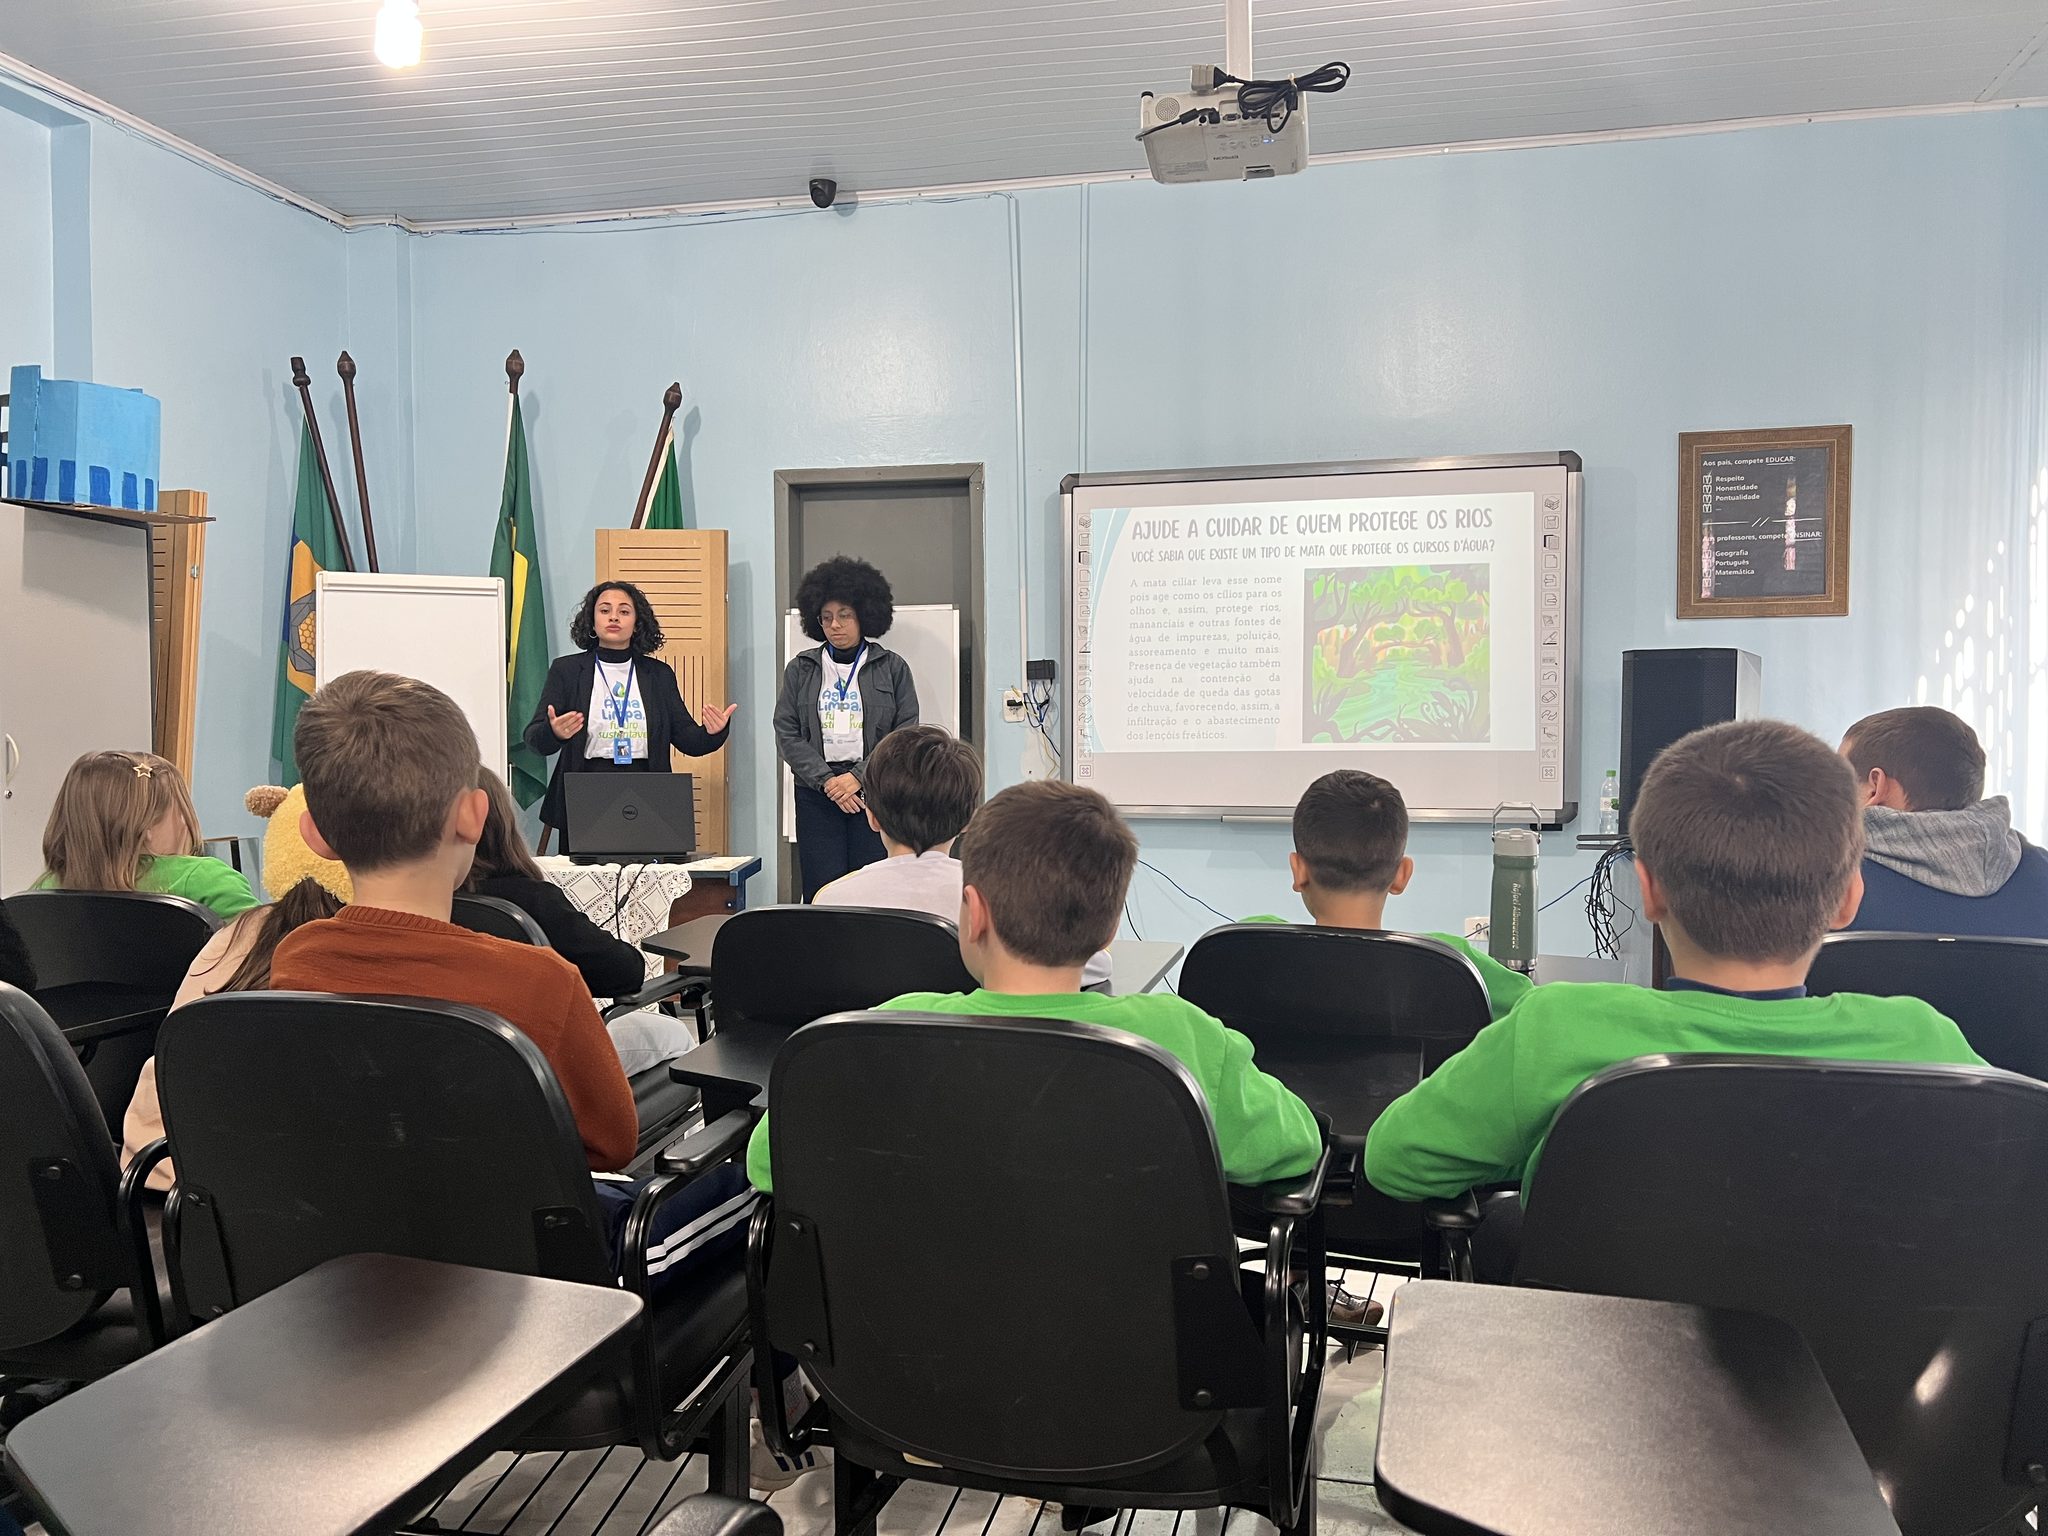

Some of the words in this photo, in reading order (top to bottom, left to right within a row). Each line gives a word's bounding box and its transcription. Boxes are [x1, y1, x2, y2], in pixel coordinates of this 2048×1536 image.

[1717, 458, 1733, 467] pais,
[1716, 475, 1744, 483] Respeito
[1716, 493, 1760, 501] Pontualidade
[1132, 520, 1180, 540] AJUDE
[1188, 519, 1198, 538] A
[1206, 516, 1262, 537] CUIDAR
[1270, 516, 1288, 535] DE
[1296, 514, 1341, 535] QUEM
[1350, 510, 1418, 532] PROTEGE
[1427, 510, 1448, 530] OS
[1456, 508, 1492, 529] RIOS
[1717, 533, 1757, 542] professores,
[1132, 548, 1154, 563] VOCÊ
[1158, 550, 1184, 562] SABIA
[1188, 549, 1206, 561] QUE
[1210, 548, 1238, 560] EXISTE
[1242, 547, 1256, 559] UM
[1261, 546, 1280, 558] TIPO
[1285, 546, 1296, 557] DE
[1300, 544, 1325, 557] MATA
[1330, 544, 1348, 556] QUE
[1352, 542, 1392, 555] PROTEGE
[1396, 542, 1408, 554] OS
[1414, 540, 1449, 553] CURSOS
[1454, 538, 1495, 552] D'ÁGUA?
[1716, 550, 1748, 558] Geografia
[1716, 559, 1749, 567] Português
[1130, 579, 1137, 587] A
[1173, 578, 1197, 587] ciliar
[1203, 577, 1221, 585] leva
[1254, 576, 1282, 584] nome
[1130, 593, 1149, 603] pois
[1153, 594, 1169, 602] age
[1217, 590, 1242, 599] cílios
[1246, 591, 1267, 600] para
[1130, 606, 1155, 615] olhos
[1162, 607, 1170, 615] e,
[1178, 605, 1208, 614] assim,
[1216, 604, 1253, 614] protege
[1260, 604, 1281, 612] rios,
[1130, 619, 1184, 629] mananciais
[1199, 618, 1230, 627] outras
[1235, 617, 1265, 626] fontes
[1270, 616, 1281, 625] de
[1129, 634, 1151, 644] água
[1158, 633, 1170, 642] de
[1177, 632, 1230, 643] impurezas,
[1236, 631, 1280, 642] poluição,
[1129, 647, 1196, 656] assoreamento
[1218, 646, 1247, 655] muito
[1129, 661, 1172, 671] Presença
[1175, 661, 1186, 669] de
[1189, 661, 1237, 670] vegetação
[1239, 659, 1280, 668] também
[1128, 676, 1154, 685] ajuda
[1200, 674, 1251, 683] contenção
[1269, 673, 1280, 681] da
[1128, 688, 1179, 698] velocidade
[1184, 688, 1195, 697] de
[1200, 687, 1229, 698] queda
[1234, 687, 1250, 696] das
[1254, 688, 1280, 698] gotas
[1128, 703, 1138, 712] de
[1141, 703, 1172, 712] chuva,
[1176, 701, 1238, 711] favorecendo,
[1241, 702, 1272, 711] assim,
[602, 709, 646, 722] Lipa,
[1128, 716, 1176, 726] infiltração
[1208, 715, 1280, 725] abastecimento
[610, 720, 638, 730] fuuro
[1127, 732, 1143, 740] dos
[1146, 730, 1179, 741] lençóis
